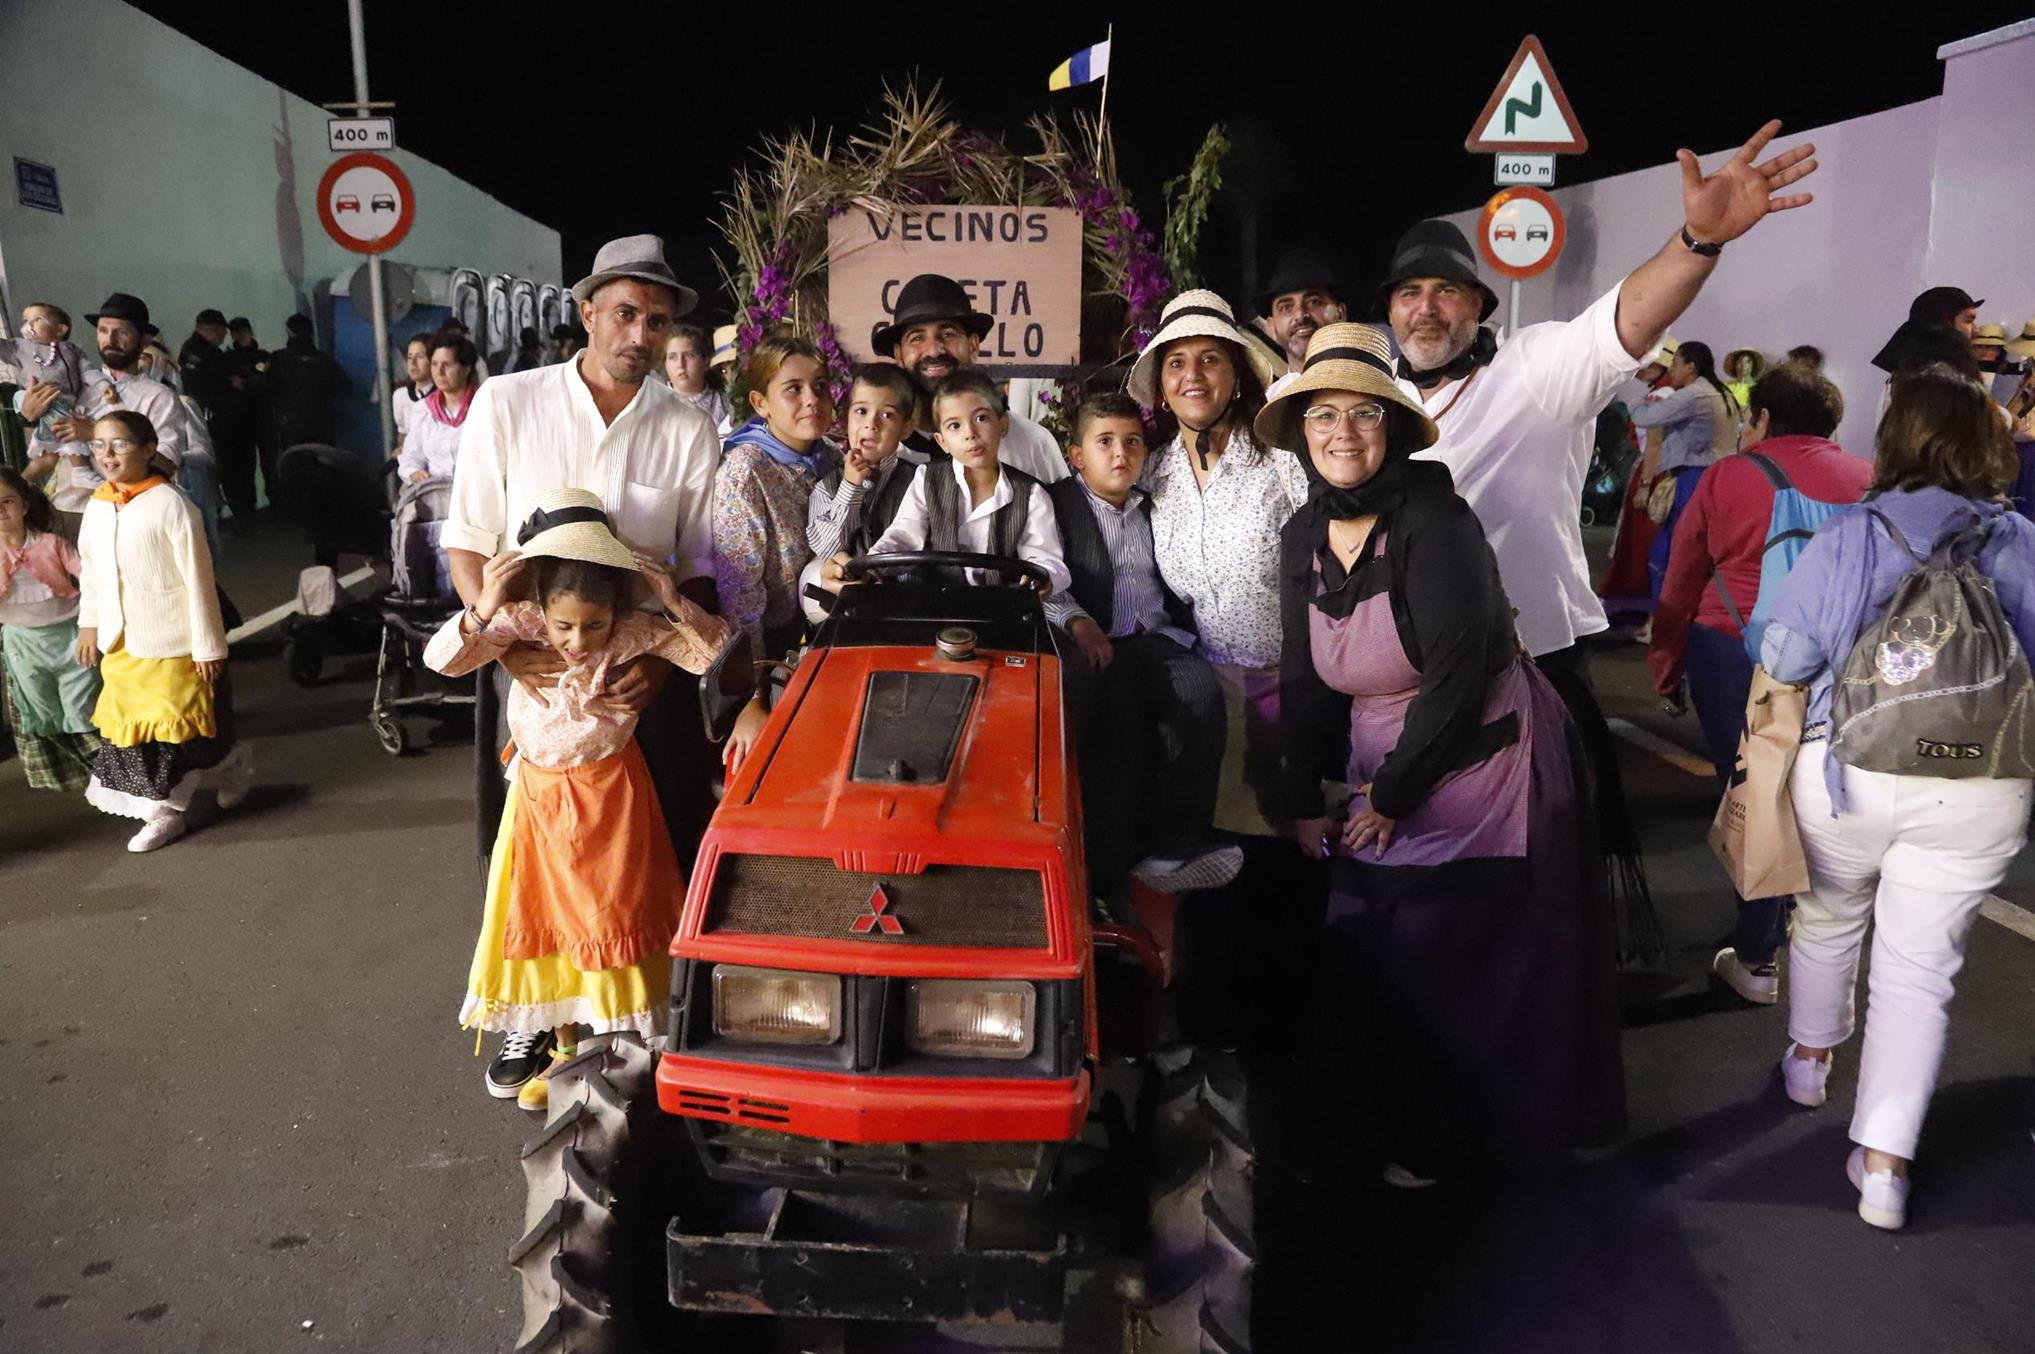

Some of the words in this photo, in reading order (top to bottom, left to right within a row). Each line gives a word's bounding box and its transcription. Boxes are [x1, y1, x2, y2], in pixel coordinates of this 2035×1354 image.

[335, 128, 368, 142] 400
[376, 131, 389, 141] m
[1501, 163, 1532, 175] 400
[1538, 167, 1550, 175] m
[866, 211, 1048, 242] VECINOS
[881, 279, 1031, 316] CETA
[1917, 738, 1983, 759] TOUS
